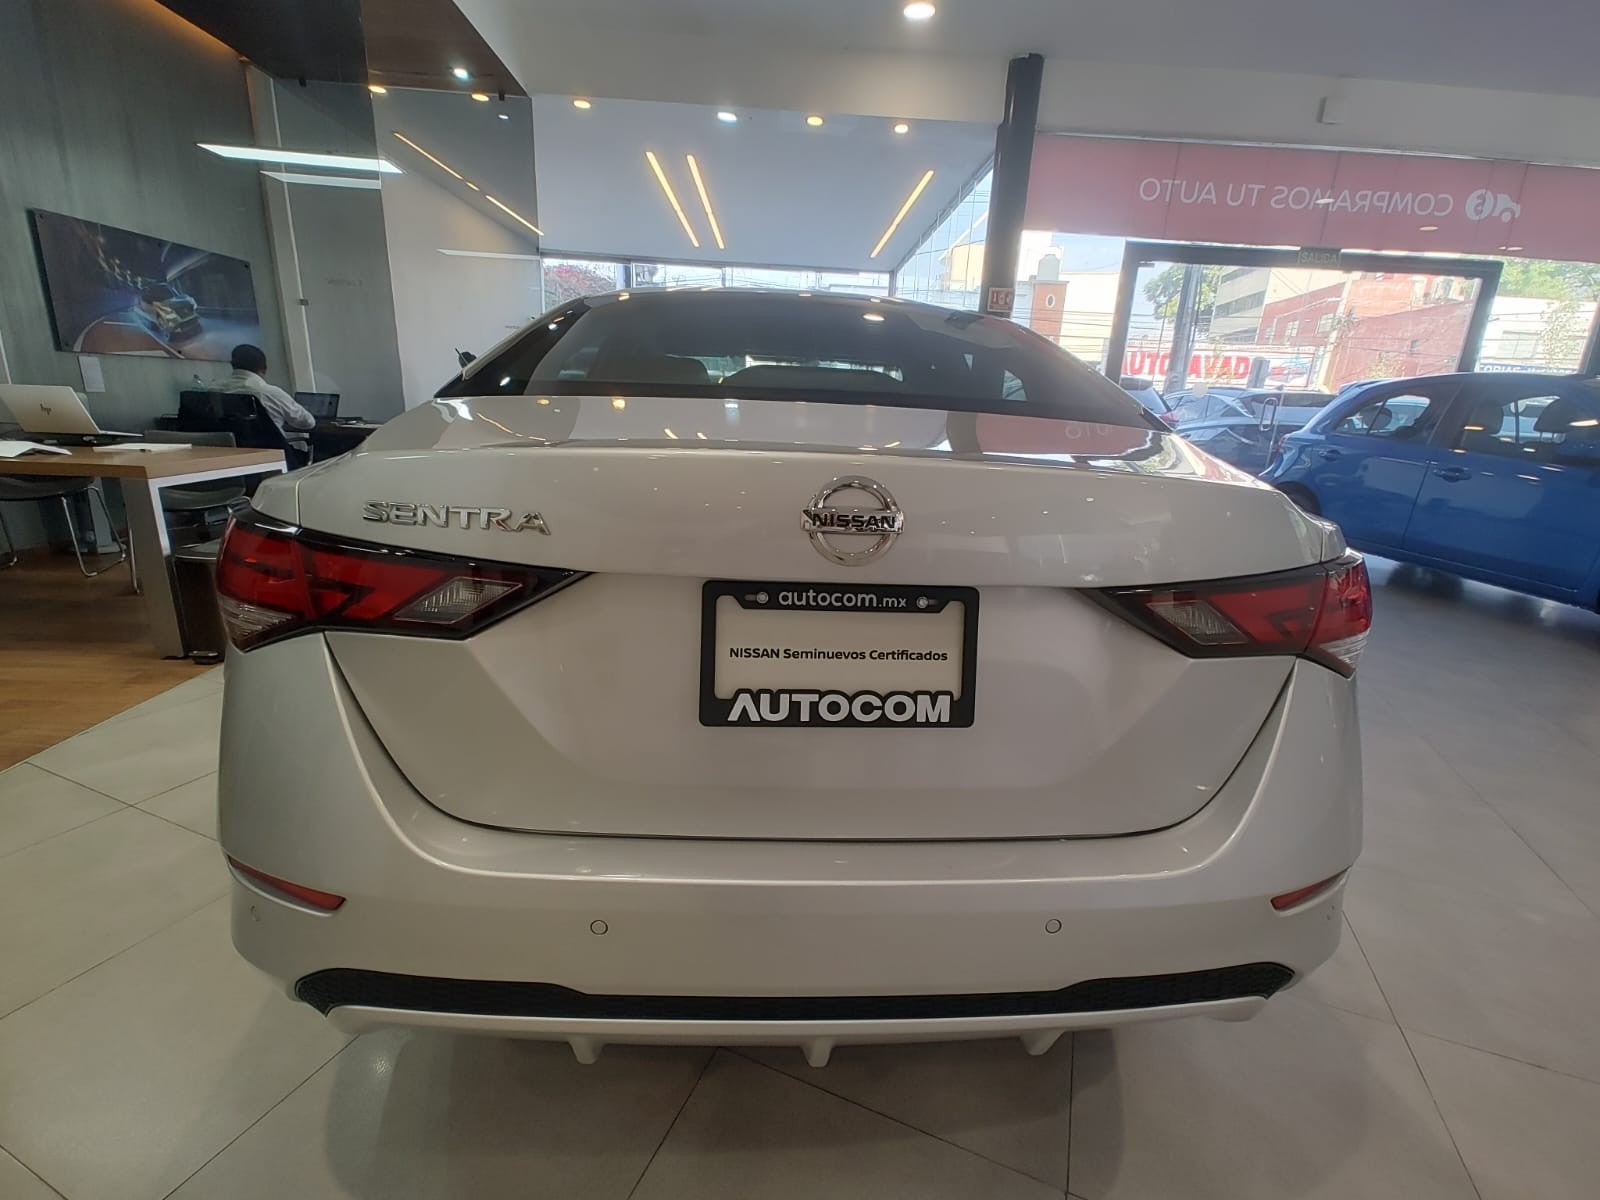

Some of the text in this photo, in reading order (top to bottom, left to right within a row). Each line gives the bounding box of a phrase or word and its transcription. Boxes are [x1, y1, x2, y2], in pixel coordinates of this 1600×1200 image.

[363, 500, 552, 536] SENTRA
[812, 513, 896, 529] NISSAN
[778, 589, 907, 608] autocom.mx
[729, 647, 948, 661] NISSAN Seminuevos Certificados
[727, 693, 951, 723] AUTOCOM
